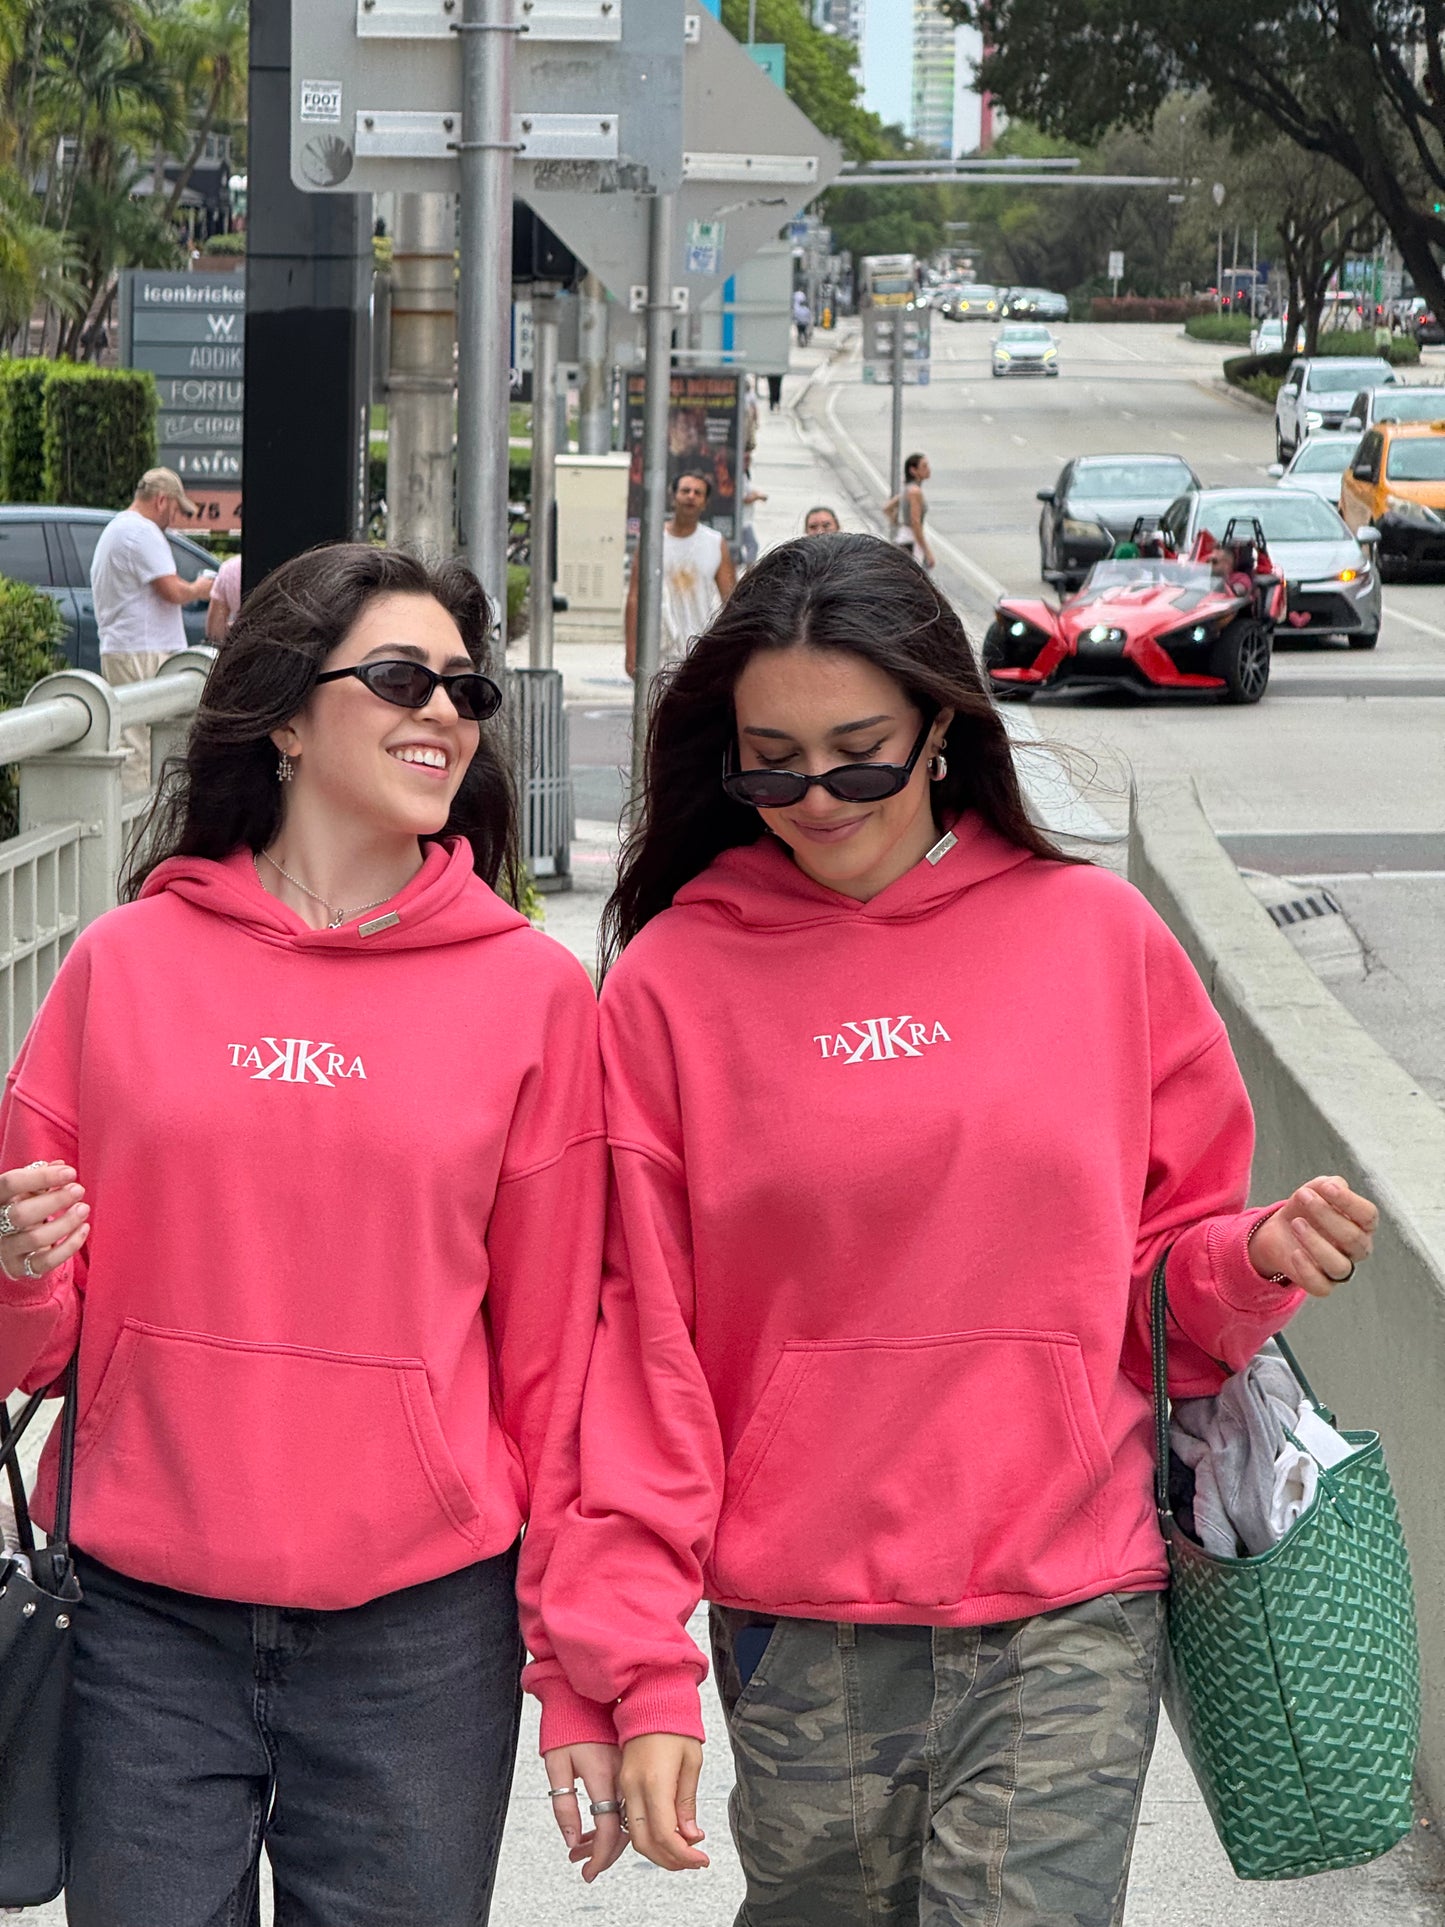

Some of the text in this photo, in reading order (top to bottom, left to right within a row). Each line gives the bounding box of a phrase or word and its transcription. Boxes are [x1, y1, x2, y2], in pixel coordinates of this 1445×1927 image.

[207, 313, 236, 336] W
[227, 1037, 367, 1088] TAKKRA
[813, 1015, 952, 1065] TAKKRA
